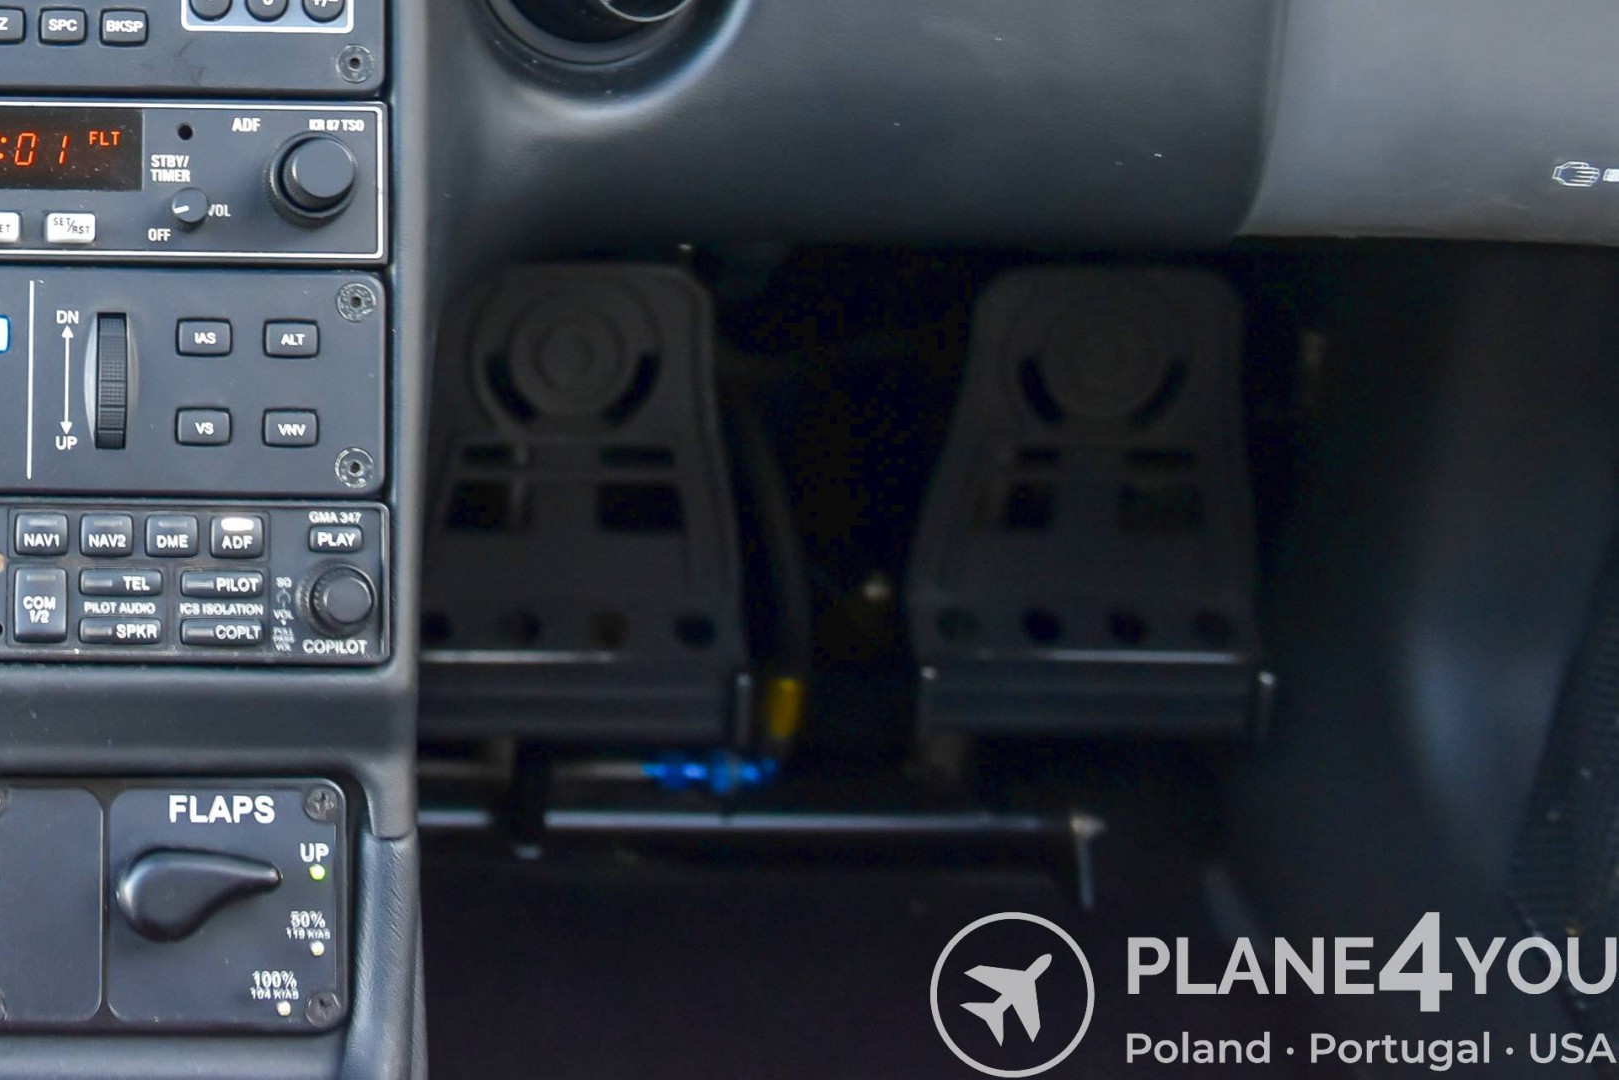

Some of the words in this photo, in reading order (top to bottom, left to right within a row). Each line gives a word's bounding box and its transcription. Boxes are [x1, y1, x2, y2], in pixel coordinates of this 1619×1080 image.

[48, 20, 78, 32] SPC
[105, 21, 143, 33] BKSP
[232, 118, 261, 132] ADF
[89, 131, 120, 146] FLT
[151, 155, 189, 169] STBY/
[150, 169, 191, 182] TIMER
[148, 228, 171, 242] OFF
[56, 310, 79, 324] DN
[195, 332, 216, 345] IAS
[281, 333, 305, 346] ALT
[195, 422, 214, 435] VS
[278, 424, 306, 437] VNV
[55, 436, 78, 450] UP
[24, 534, 59, 547] NAV1
[89, 534, 126, 548] NAV2
[157, 535, 188, 548] DME
[222, 535, 253, 549] ADF
[318, 532, 355, 546] PLAY
[123, 576, 150, 591] TEL
[216, 577, 259, 592] PILOT
[23, 596, 55, 610] COM
[84, 602, 115, 614] PILOT
[121, 602, 155, 614] AUDIO
[203, 603, 263, 615] ISOLATION
[116, 624, 157, 639] SPKR
[216, 625, 261, 639] COPLT
[303, 640, 367, 654] COPILOT
[169, 795, 275, 824] FLAPS
[300, 843, 329, 862] UP
[291, 911, 325, 928] 50%
[252, 970, 297, 989] 100%
